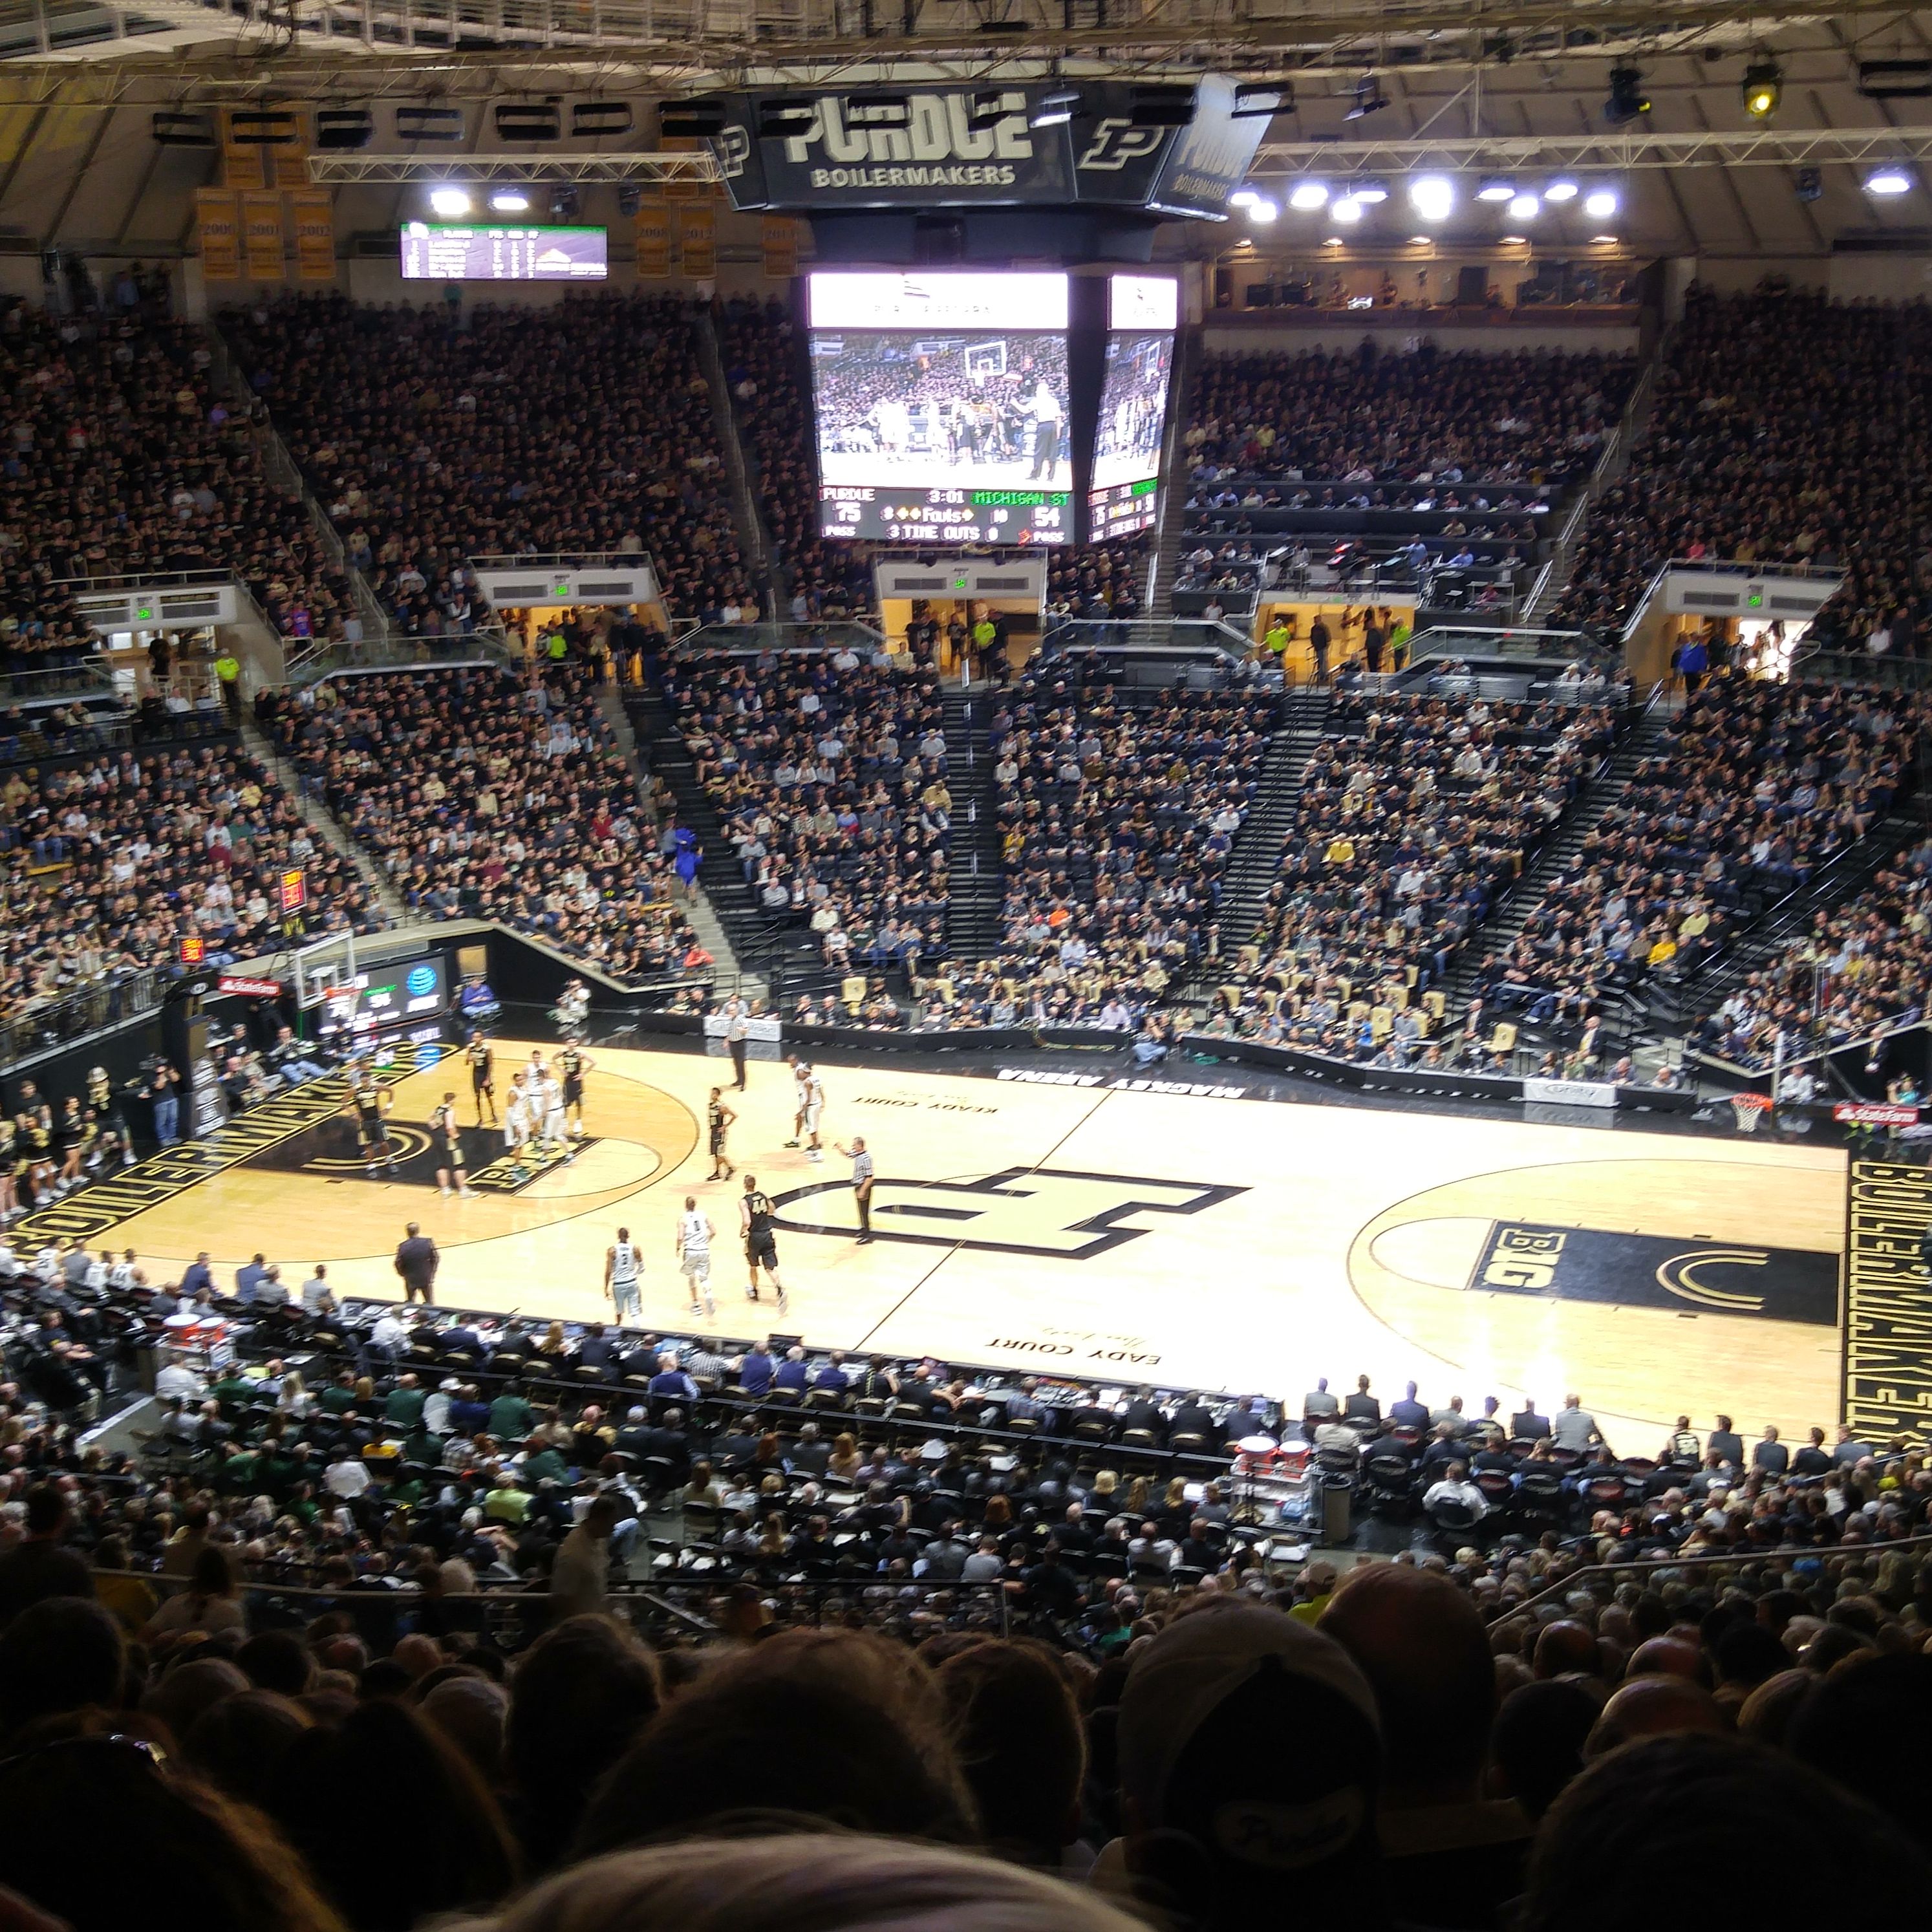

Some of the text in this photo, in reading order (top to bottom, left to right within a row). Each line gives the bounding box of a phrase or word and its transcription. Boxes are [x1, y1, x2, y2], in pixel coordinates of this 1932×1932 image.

[811, 165, 1016, 188] BOILERMAKERS
[821, 487, 875, 502] PURDUE
[927, 489, 965, 504] 3:01
[971, 491, 1070, 507] MICHIGAN ST
[833, 501, 861, 522] 75
[922, 507, 961, 524] Fouls
[1033, 507, 1061, 527] 54
[887, 524, 899, 539] 3
[903, 525, 939, 541] TIME
[943, 525, 980, 541] OUTS
[996, 1069, 1247, 1099] MACKEY ARENA
[851, 1097, 999, 1114] KEADY COURT
[751, 1195, 768, 1215] 44
[984, 1338, 1074, 1355] COURT
[1086, 1349, 1163, 1365] EADY
